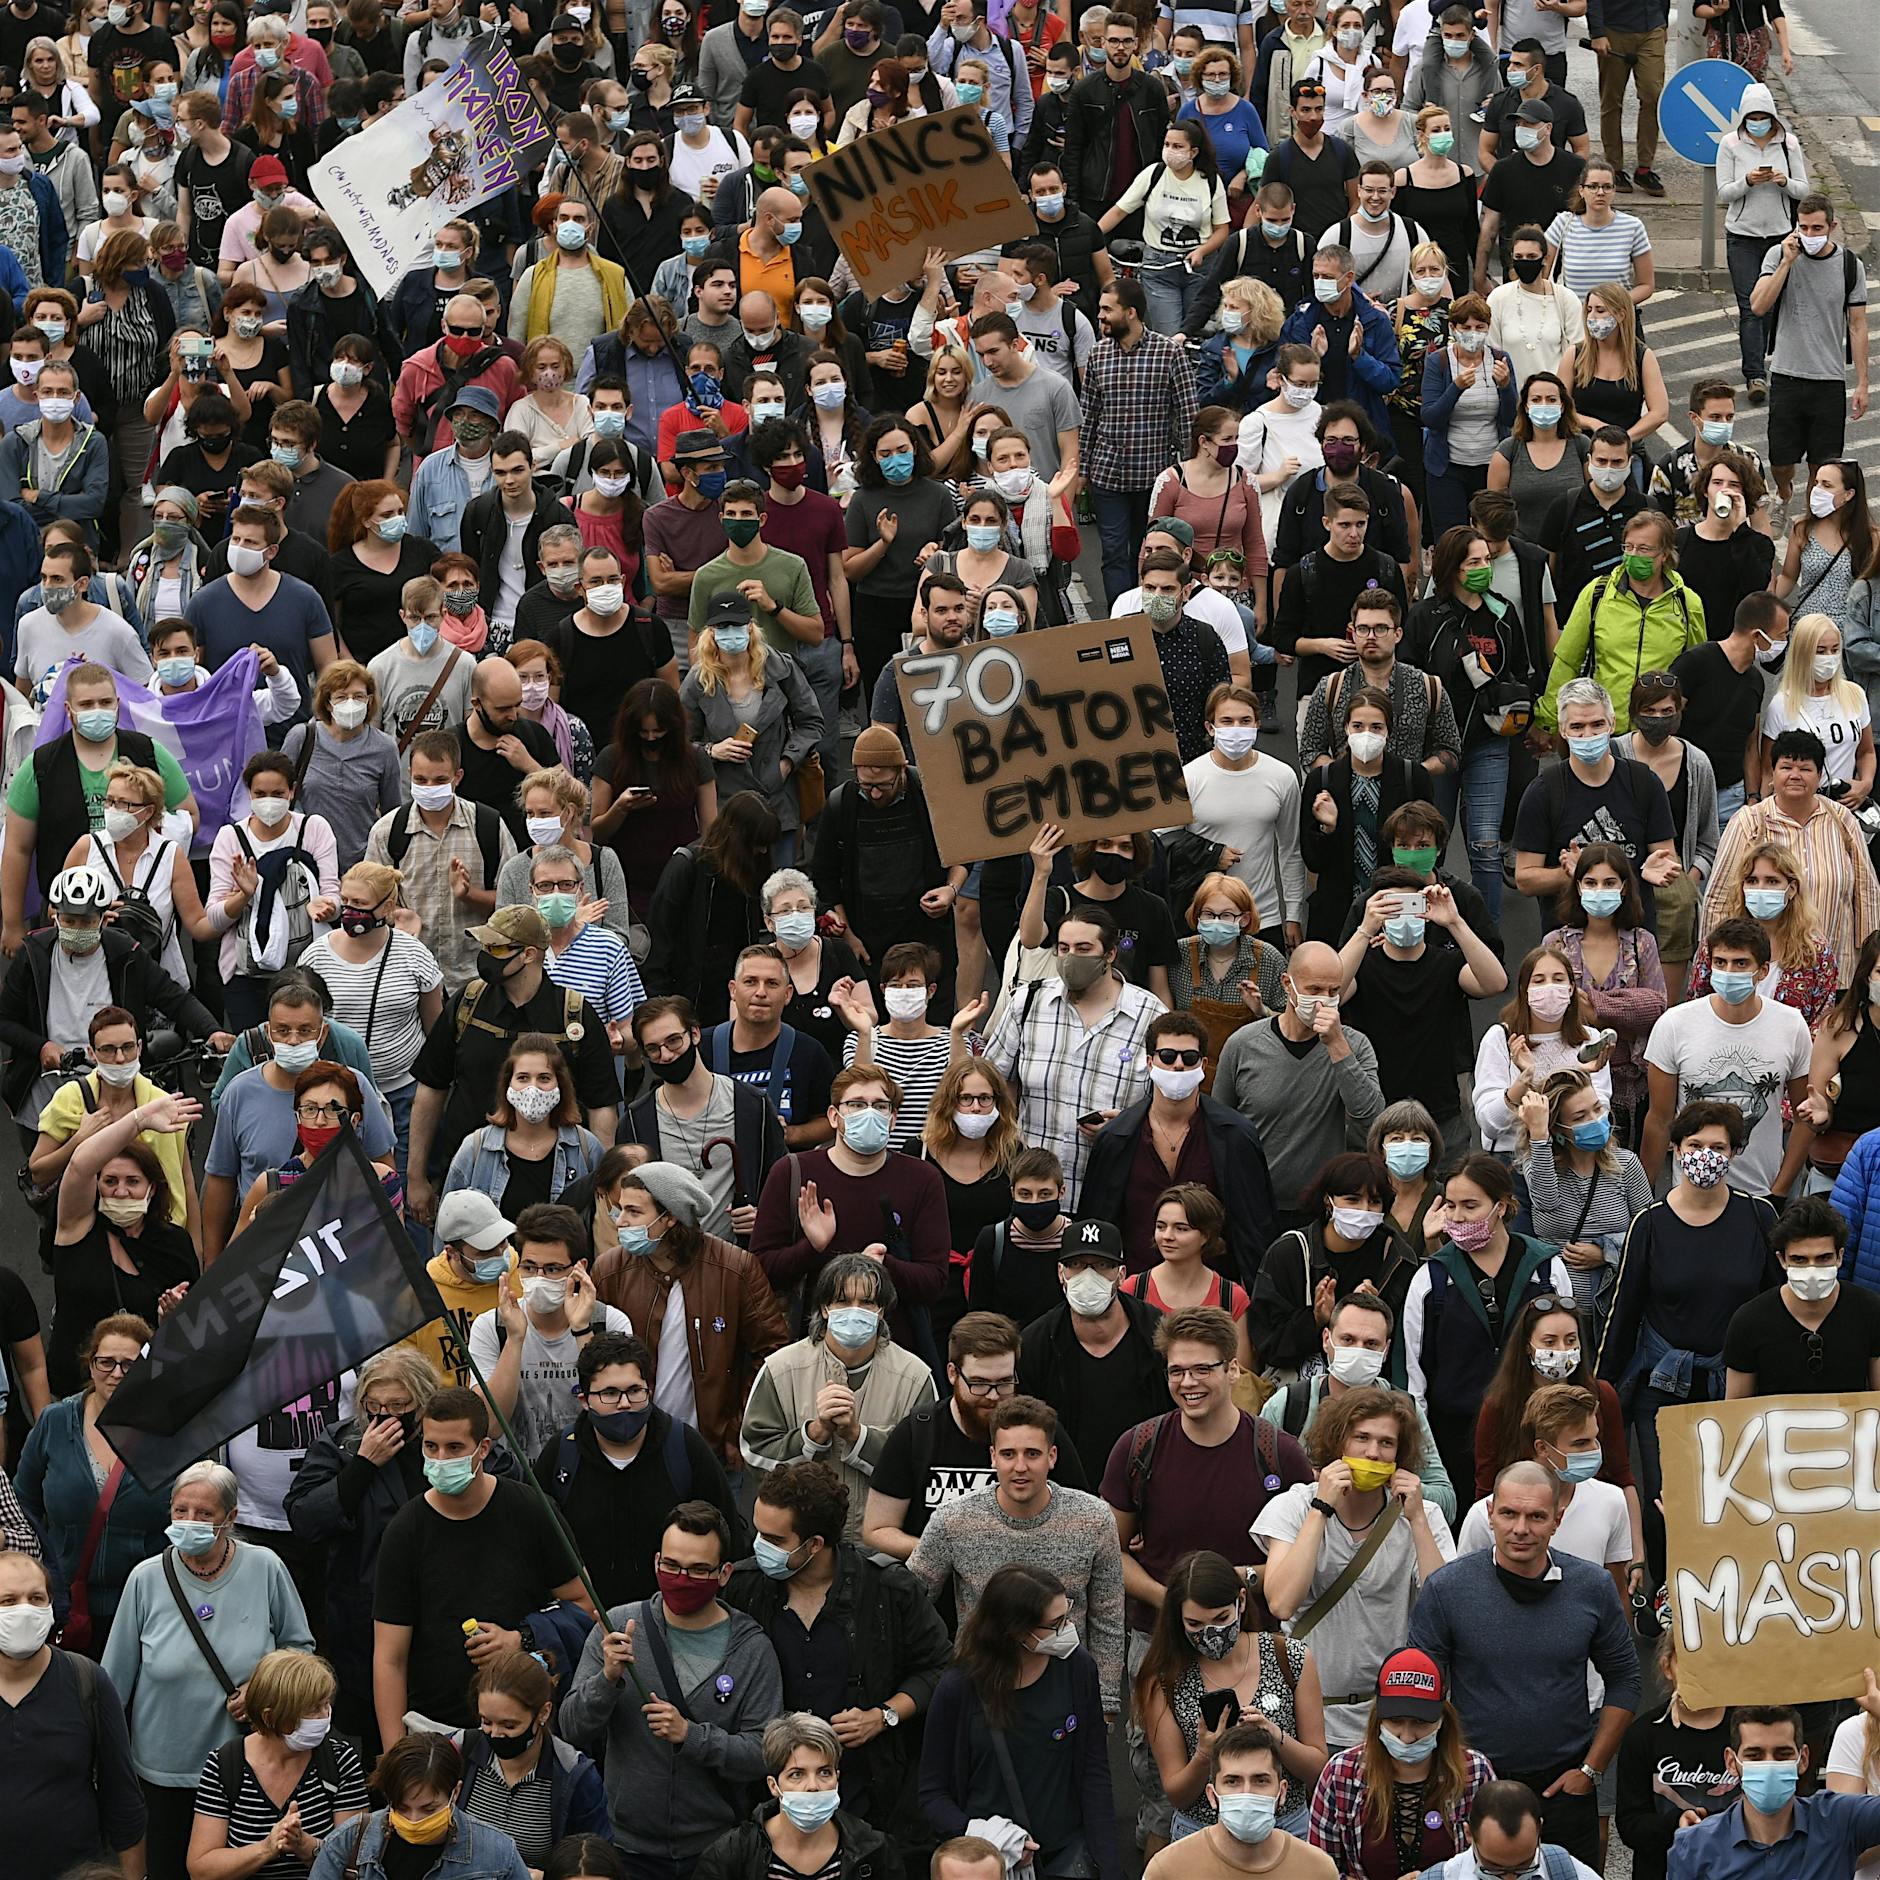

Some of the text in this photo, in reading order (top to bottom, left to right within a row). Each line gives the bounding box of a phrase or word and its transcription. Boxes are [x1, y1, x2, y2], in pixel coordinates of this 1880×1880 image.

[441, 59, 519, 196] MAIDEN
[486, 45, 550, 151] IRON
[328, 165, 346, 181] CAN
[813, 114, 992, 221] NINCS
[841, 179, 967, 277] MÁSIK
[902, 646, 1024, 735] 70
[1110, 645, 1129, 655] NEM
[983, 750, 1190, 838] EMBER
[1081, 1224, 1100, 1243] NY
[534, 1370, 539, 1380] 5
[1386, 1671, 1435, 1689] ARIZONA
